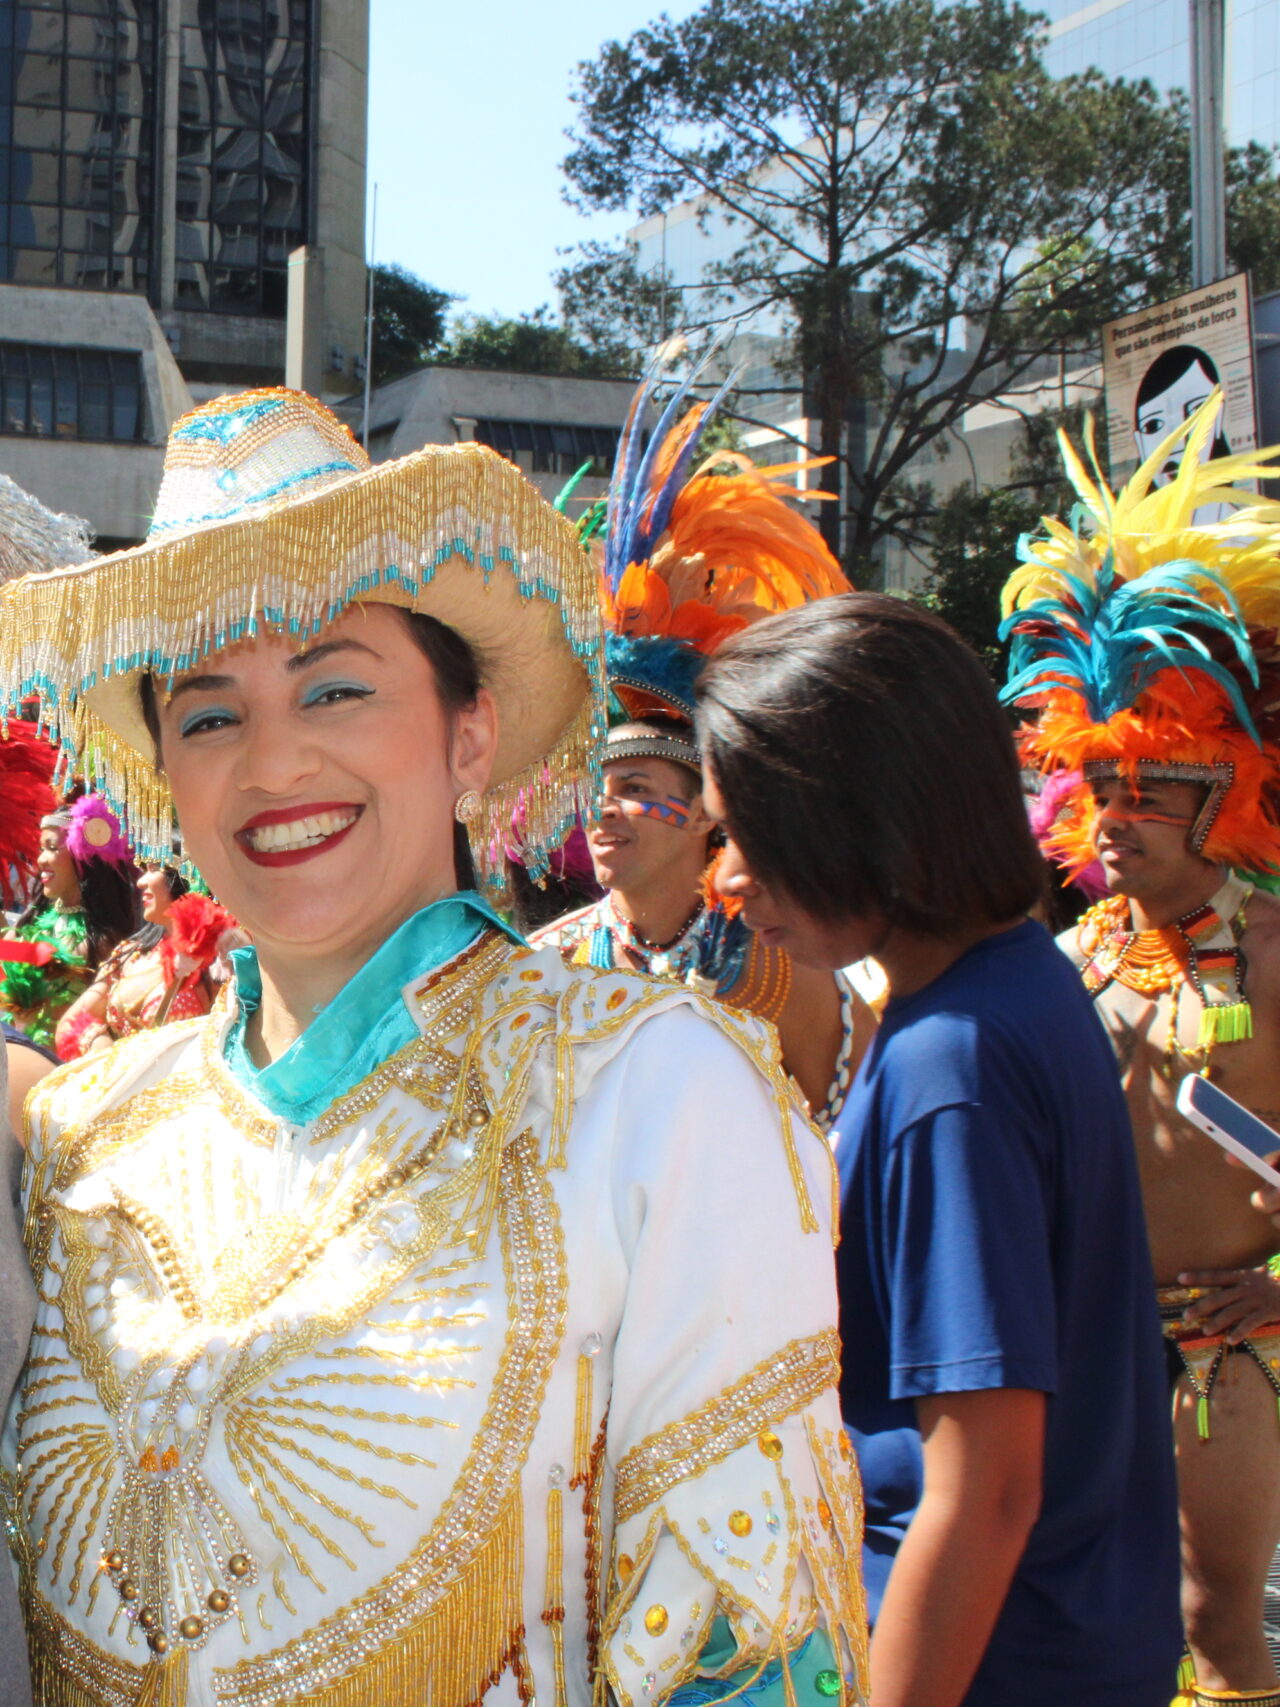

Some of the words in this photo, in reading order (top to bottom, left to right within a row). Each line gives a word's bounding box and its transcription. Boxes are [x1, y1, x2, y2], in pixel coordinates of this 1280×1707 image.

[1172, 305, 1188, 320] das
[1190, 289, 1236, 313] mulheres
[1115, 344, 1131, 359] que
[1151, 321, 1196, 344] exemplos
[1198, 315, 1210, 328] de
[1211, 307, 1236, 325] força
